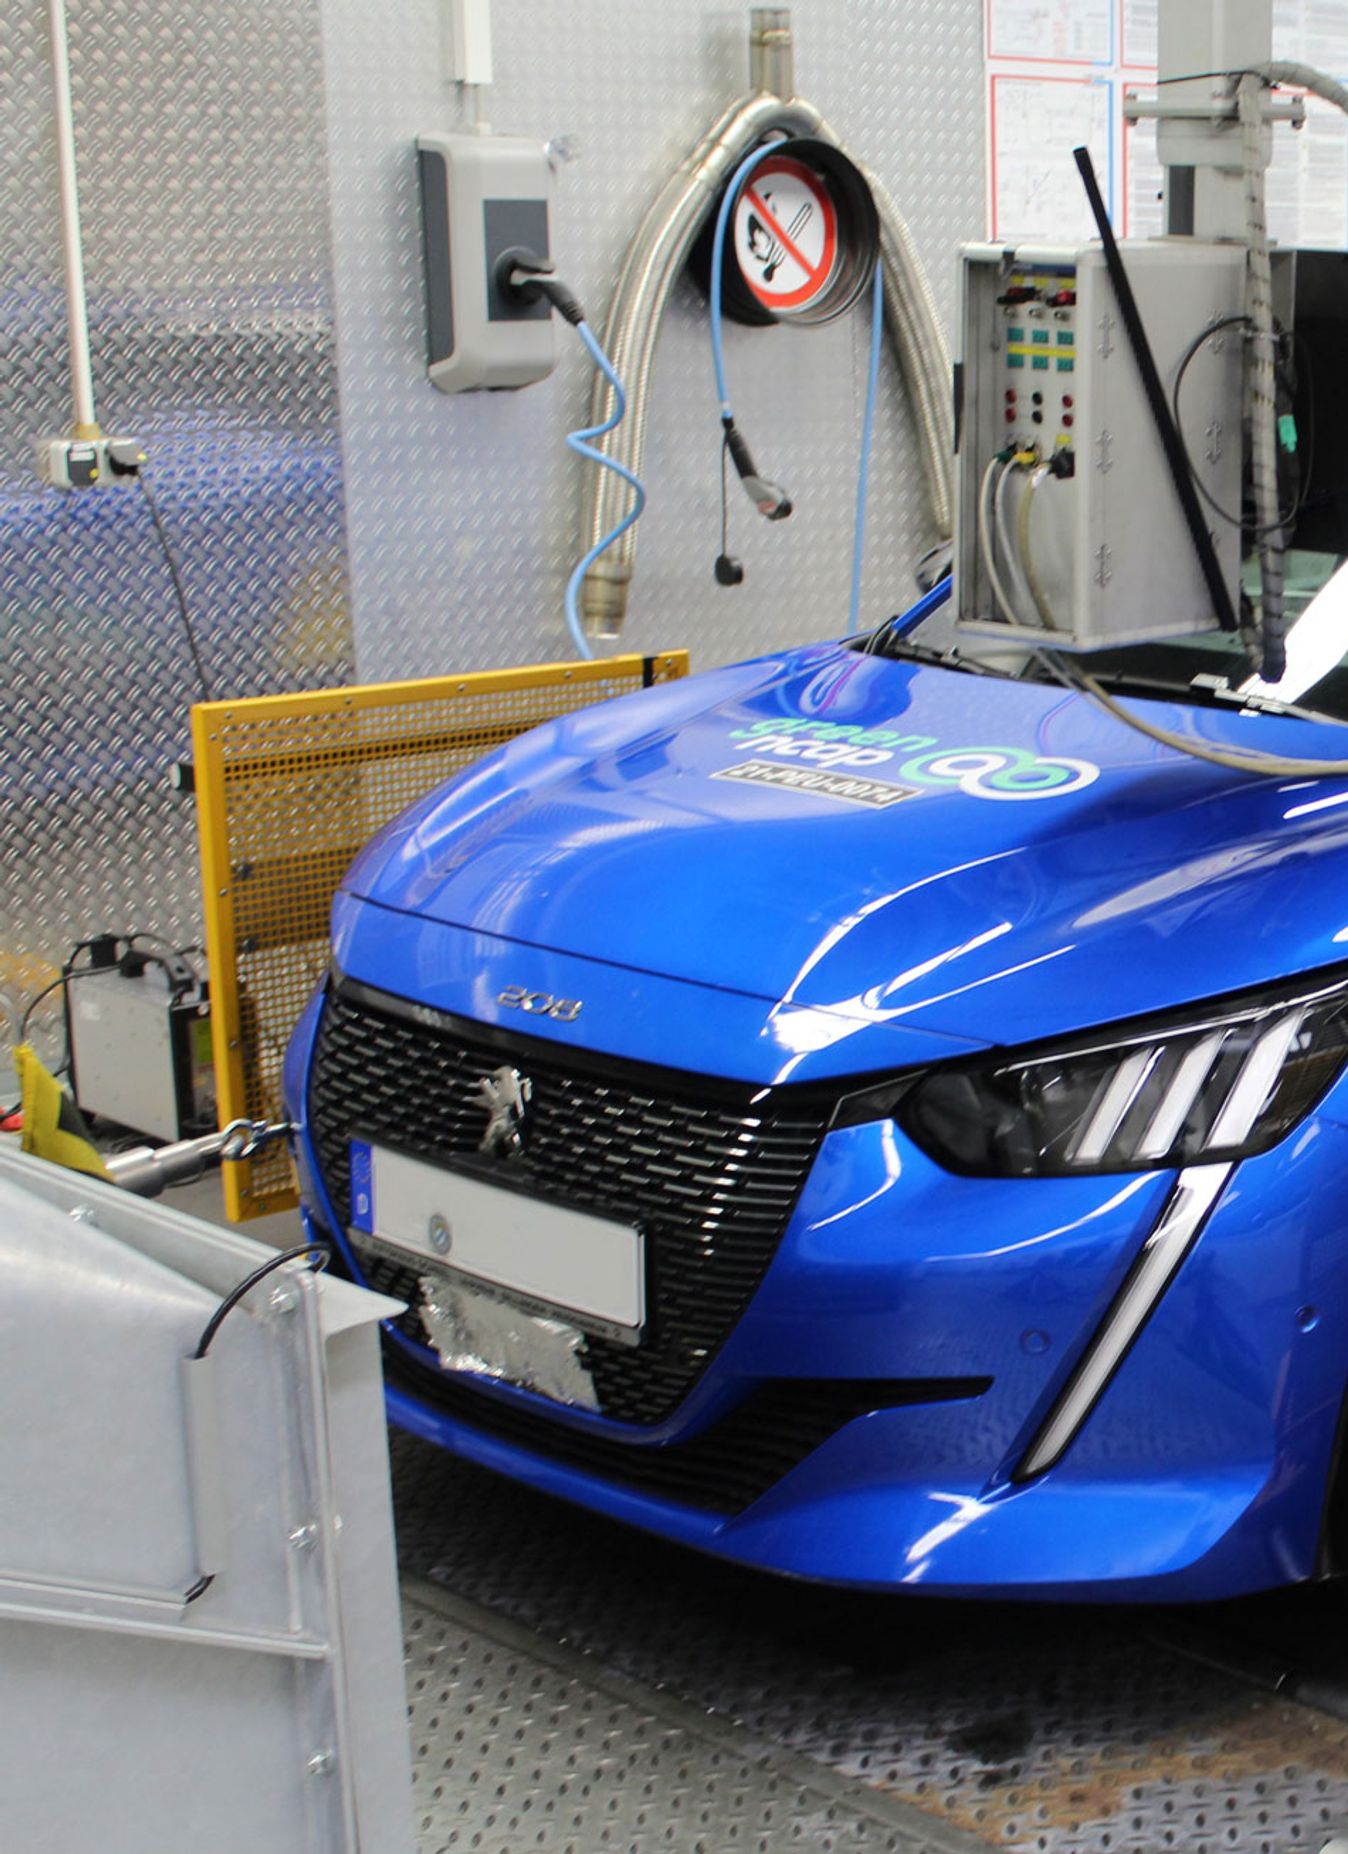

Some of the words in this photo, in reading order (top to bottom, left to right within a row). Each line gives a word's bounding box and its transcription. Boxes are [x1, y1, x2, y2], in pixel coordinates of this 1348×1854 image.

[728, 717, 939, 752] green
[734, 734, 895, 769] ncap
[496, 984, 583, 1022] 208
